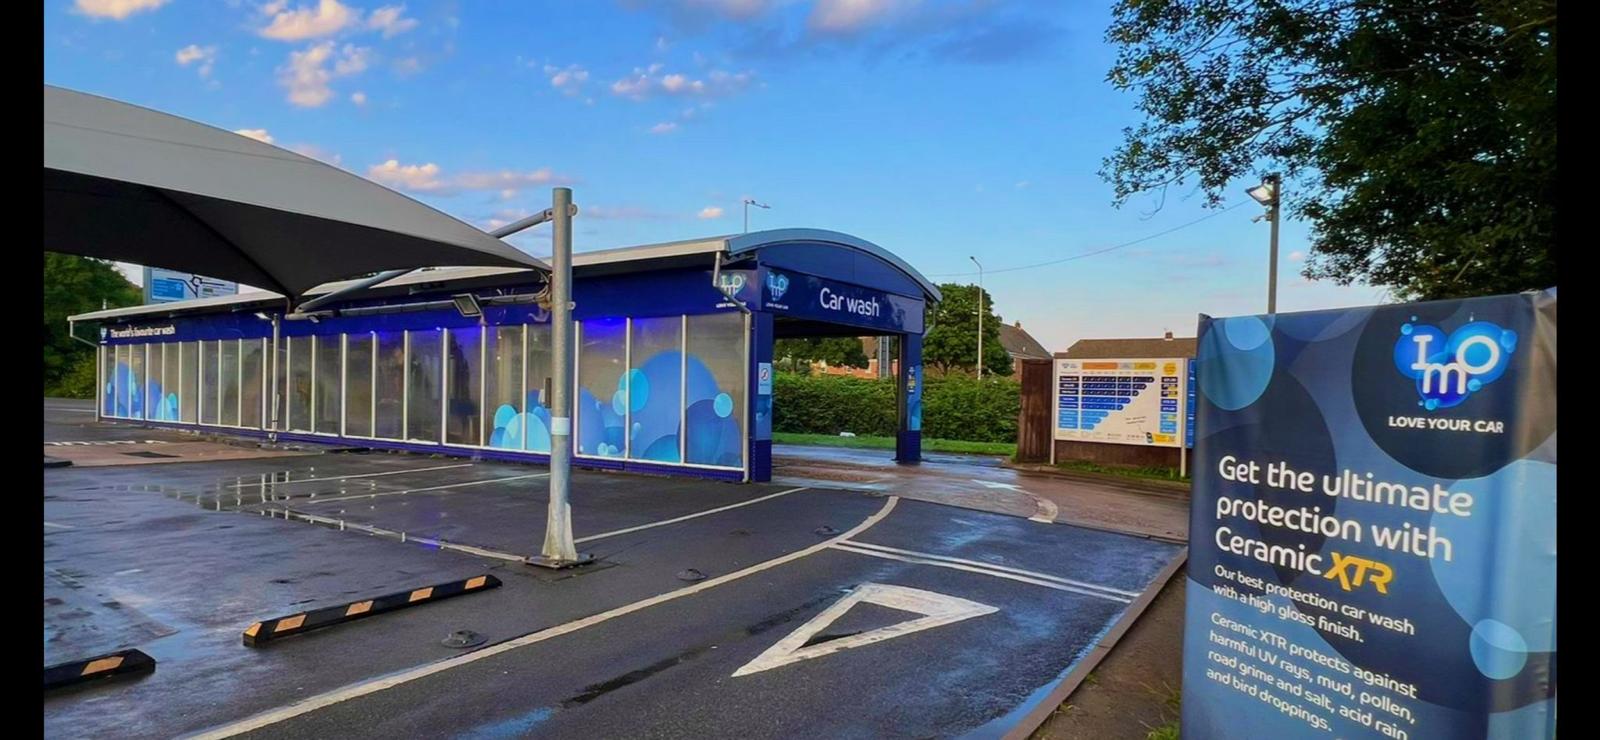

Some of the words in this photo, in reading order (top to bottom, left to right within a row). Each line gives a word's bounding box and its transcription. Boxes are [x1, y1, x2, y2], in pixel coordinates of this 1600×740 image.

[820, 287, 844, 311] Car
[846, 297, 880, 317] wash
[1388, 416, 1426, 428] LOVE
[1428, 418, 1471, 431] YOUR
[1474, 421, 1504, 433] CAR
[1219, 455, 1260, 484] Get
[1267, 461, 1315, 492] the
[1322, 469, 1473, 517] ultimate
[1215, 526, 1323, 576] Ceramic
[1323, 551, 1394, 594] XTR
[1216, 496, 1362, 543] protection
[1371, 522, 1452, 561] with
[1212, 583, 1238, 601] with
[1239, 593, 1247, 605] a
[1248, 593, 1275, 614] high
[1278, 605, 1315, 627] gloss
[1318, 615, 1364, 643] finish.
[1214, 564, 1237, 581] Our
[1237, 568, 1264, 591] best
[1265, 581, 1338, 612] protection
[1341, 603, 1366, 620] car
[1368, 611, 1415, 635] wash
[1209, 630, 1256, 657] harmful
[1258, 648, 1278, 665] UV
[1280, 658, 1313, 683] rays,
[1317, 673, 1355, 700] mud,
[1360, 691, 1415, 724] pollen,
[1211, 612, 1258, 640] Ceramic
[1259, 629, 1287, 650] XTR
[1289, 642, 1350, 674] protects
[1353, 664, 1418, 699] against
[1206, 667, 1231, 685] and
[1232, 676, 1257, 697] bird
[1259, 689, 1333, 733] droppings.
[1208, 650, 1237, 669] road
[1239, 661, 1274, 686] grime
[1277, 677, 1302, 697] and
[1304, 689, 1335, 714] salt,
[1339, 703, 1372, 727] acid
[1375, 719, 1408, 740] rain
